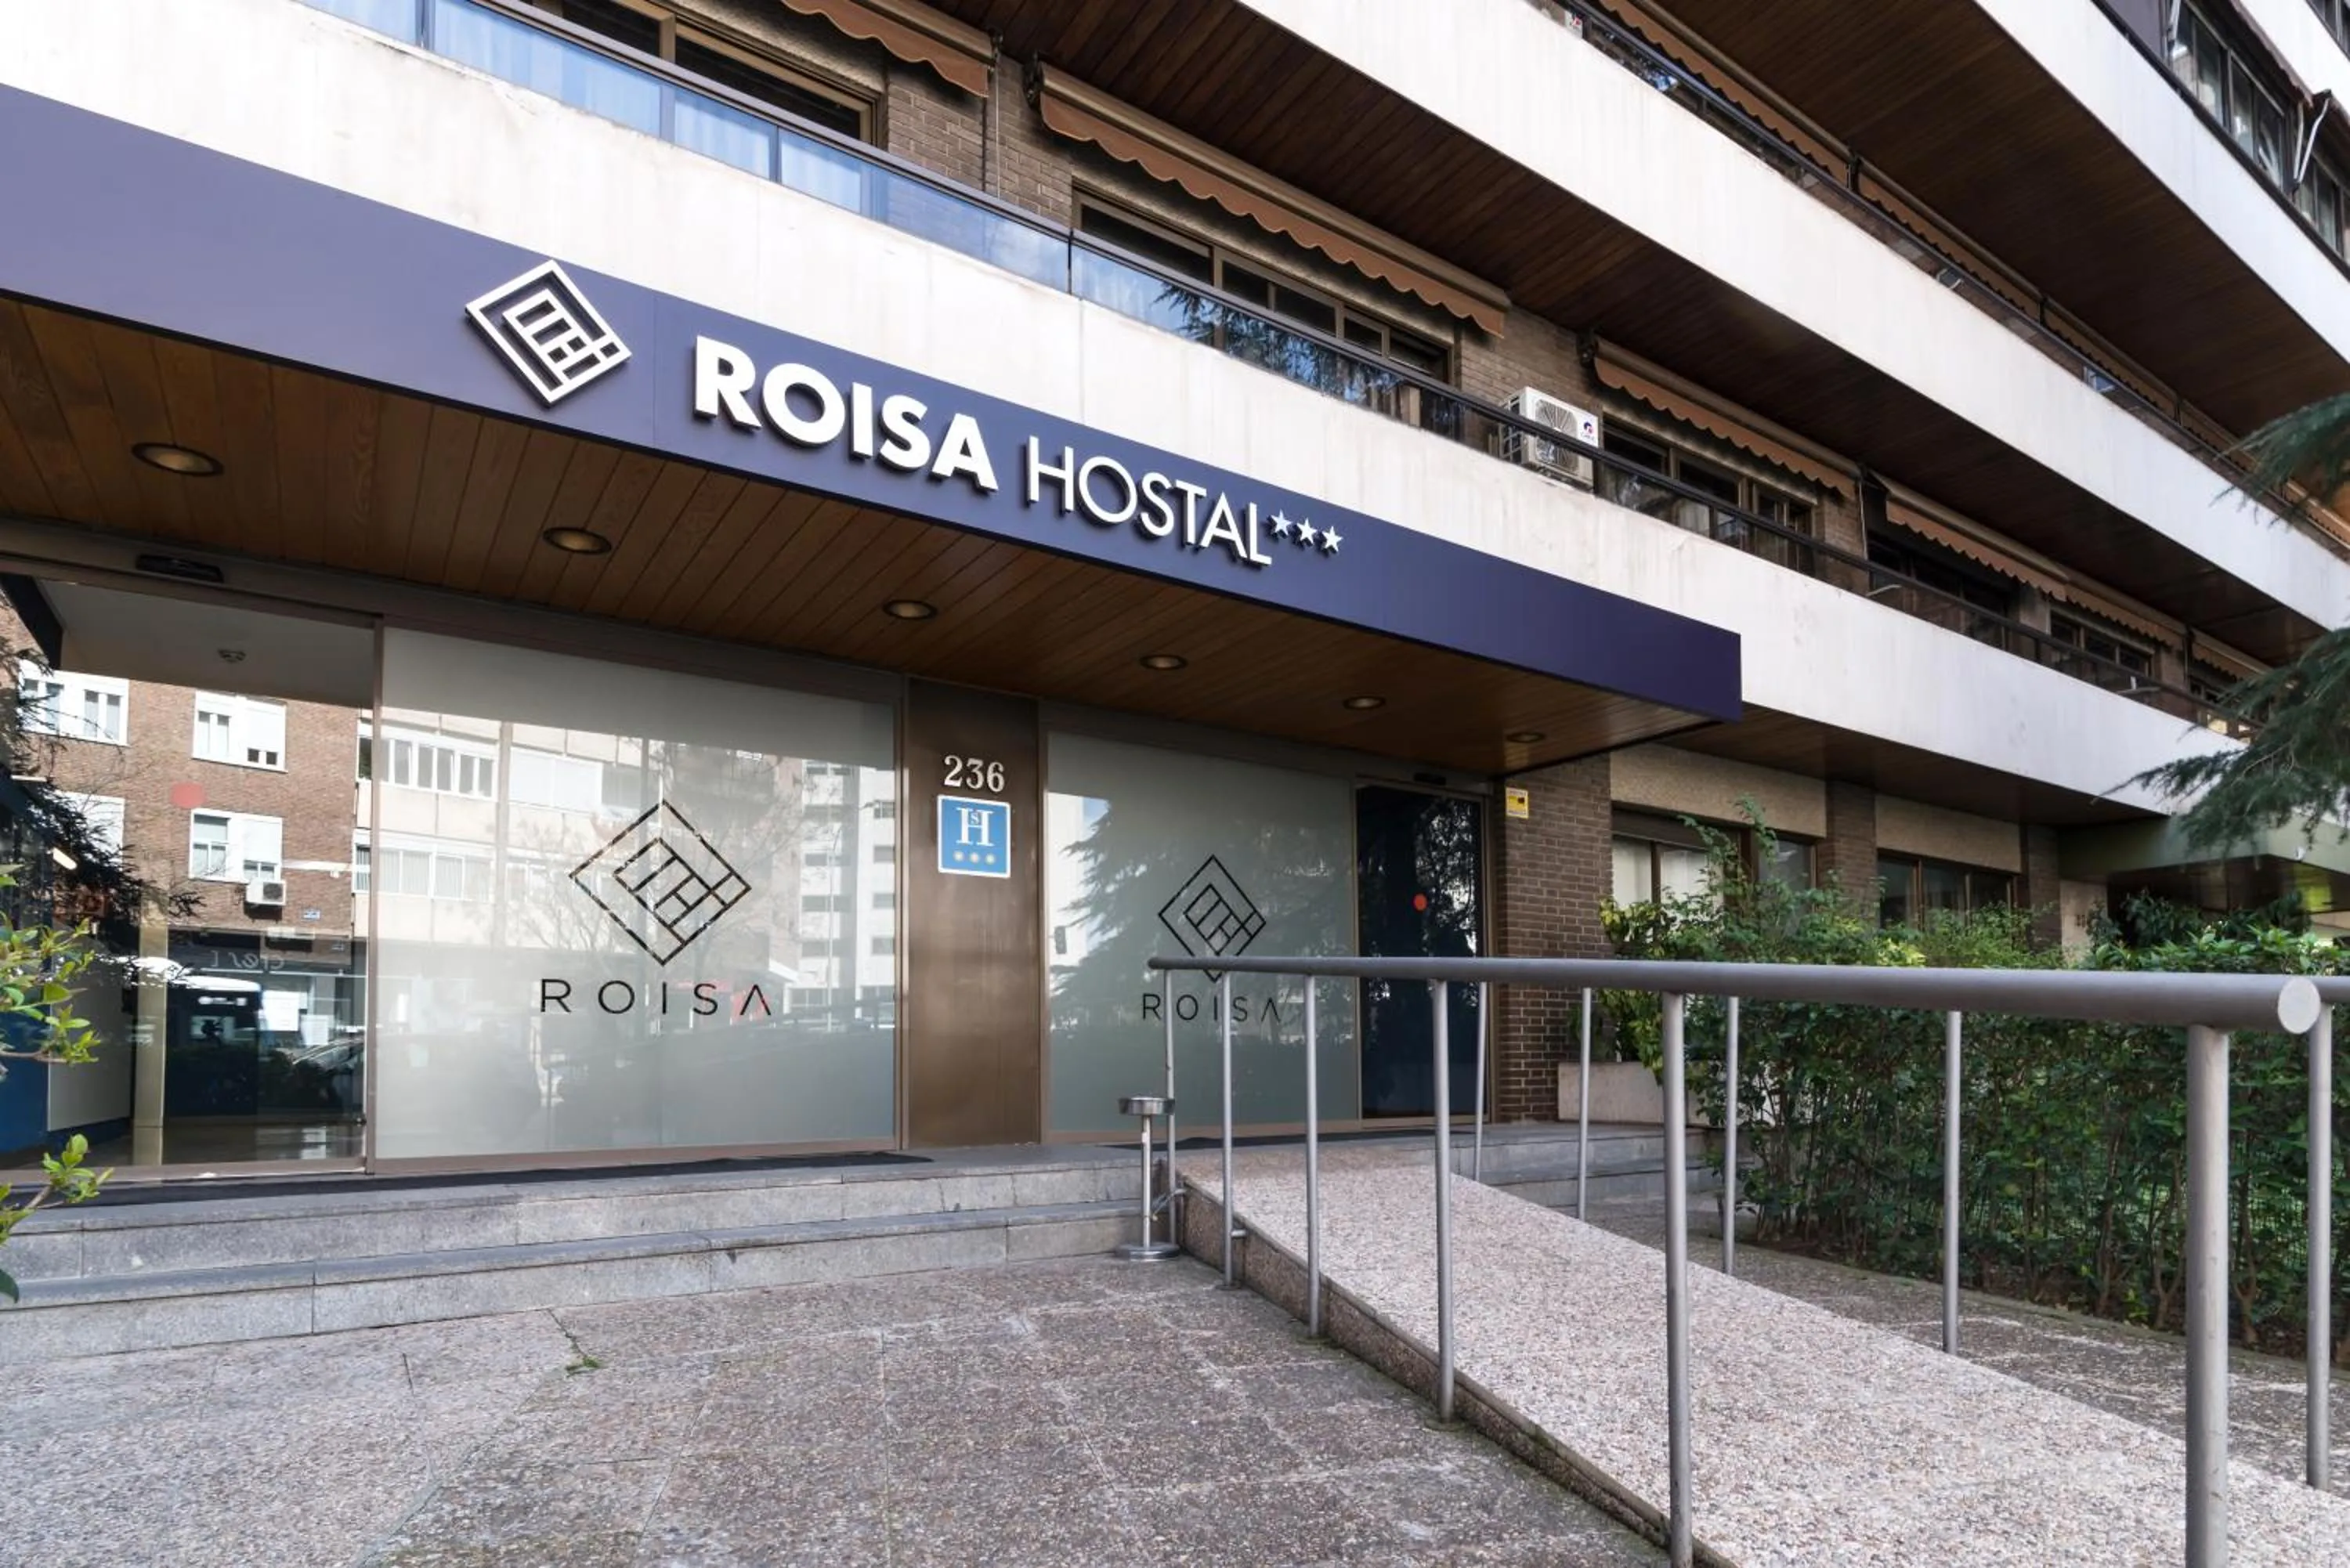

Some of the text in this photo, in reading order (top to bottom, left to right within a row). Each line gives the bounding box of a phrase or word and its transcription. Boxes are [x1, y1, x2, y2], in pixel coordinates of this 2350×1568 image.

[694, 335, 1272, 565] ROISA HOSTAL
[944, 754, 1005, 793] 236
[540, 978, 772, 1016] ROISA
[1142, 993, 1282, 1022] ROISA
